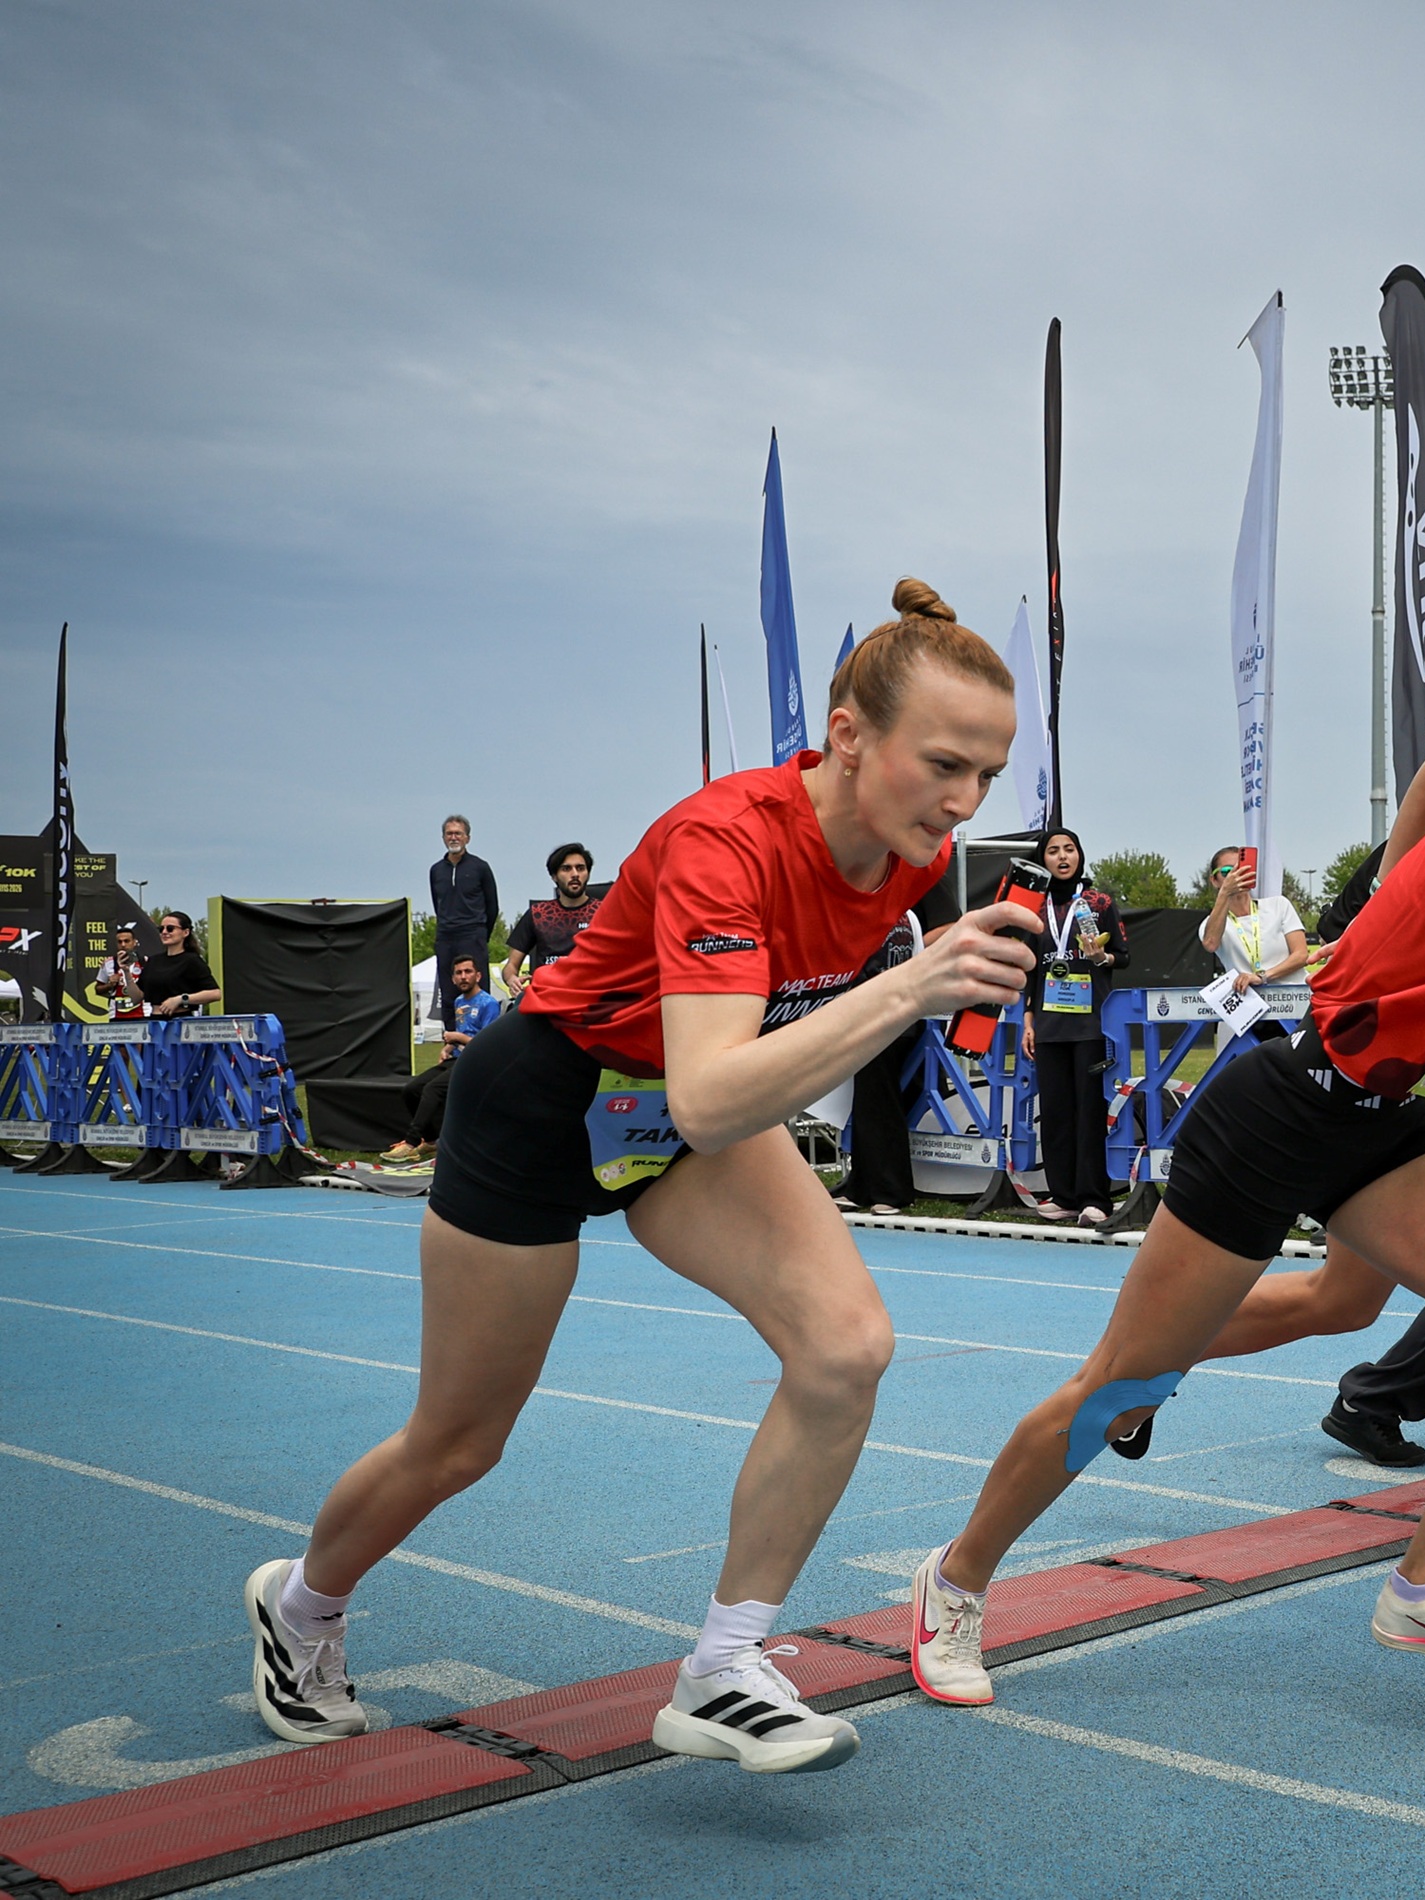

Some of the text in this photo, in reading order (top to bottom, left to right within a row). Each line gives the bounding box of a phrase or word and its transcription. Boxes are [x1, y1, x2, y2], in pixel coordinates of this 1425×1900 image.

[5, 868, 36, 878] 10K
[86, 922, 108, 933] FEEL
[88, 939, 107, 951] THE
[816, 970, 855, 990] TEAM
[1267, 991, 1311, 1002] BELEDİYESİ
